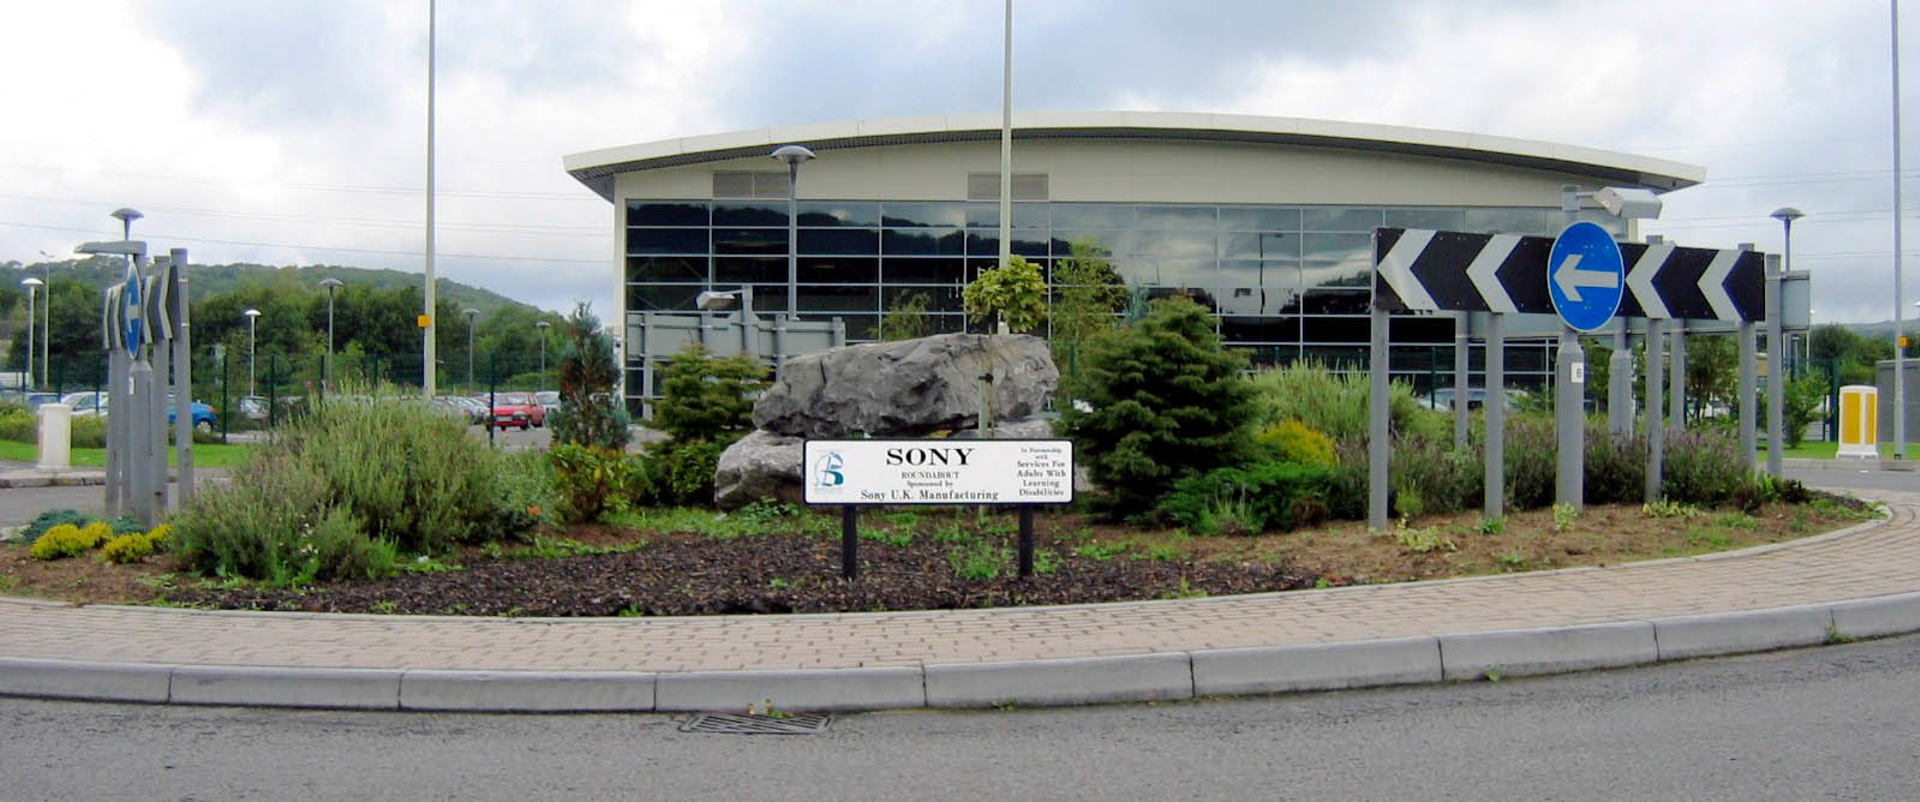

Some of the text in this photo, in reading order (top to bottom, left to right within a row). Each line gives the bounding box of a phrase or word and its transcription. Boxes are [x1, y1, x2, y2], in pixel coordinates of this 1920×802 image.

[886, 448, 974, 466] SONY
[901, 471, 960, 479] ROUNDABOUT
[1022, 479, 1061, 487] Learning
[860, 489, 1000, 500] Sony U.K. Manufacturing
[1018, 488, 1065, 497] Disabilities
